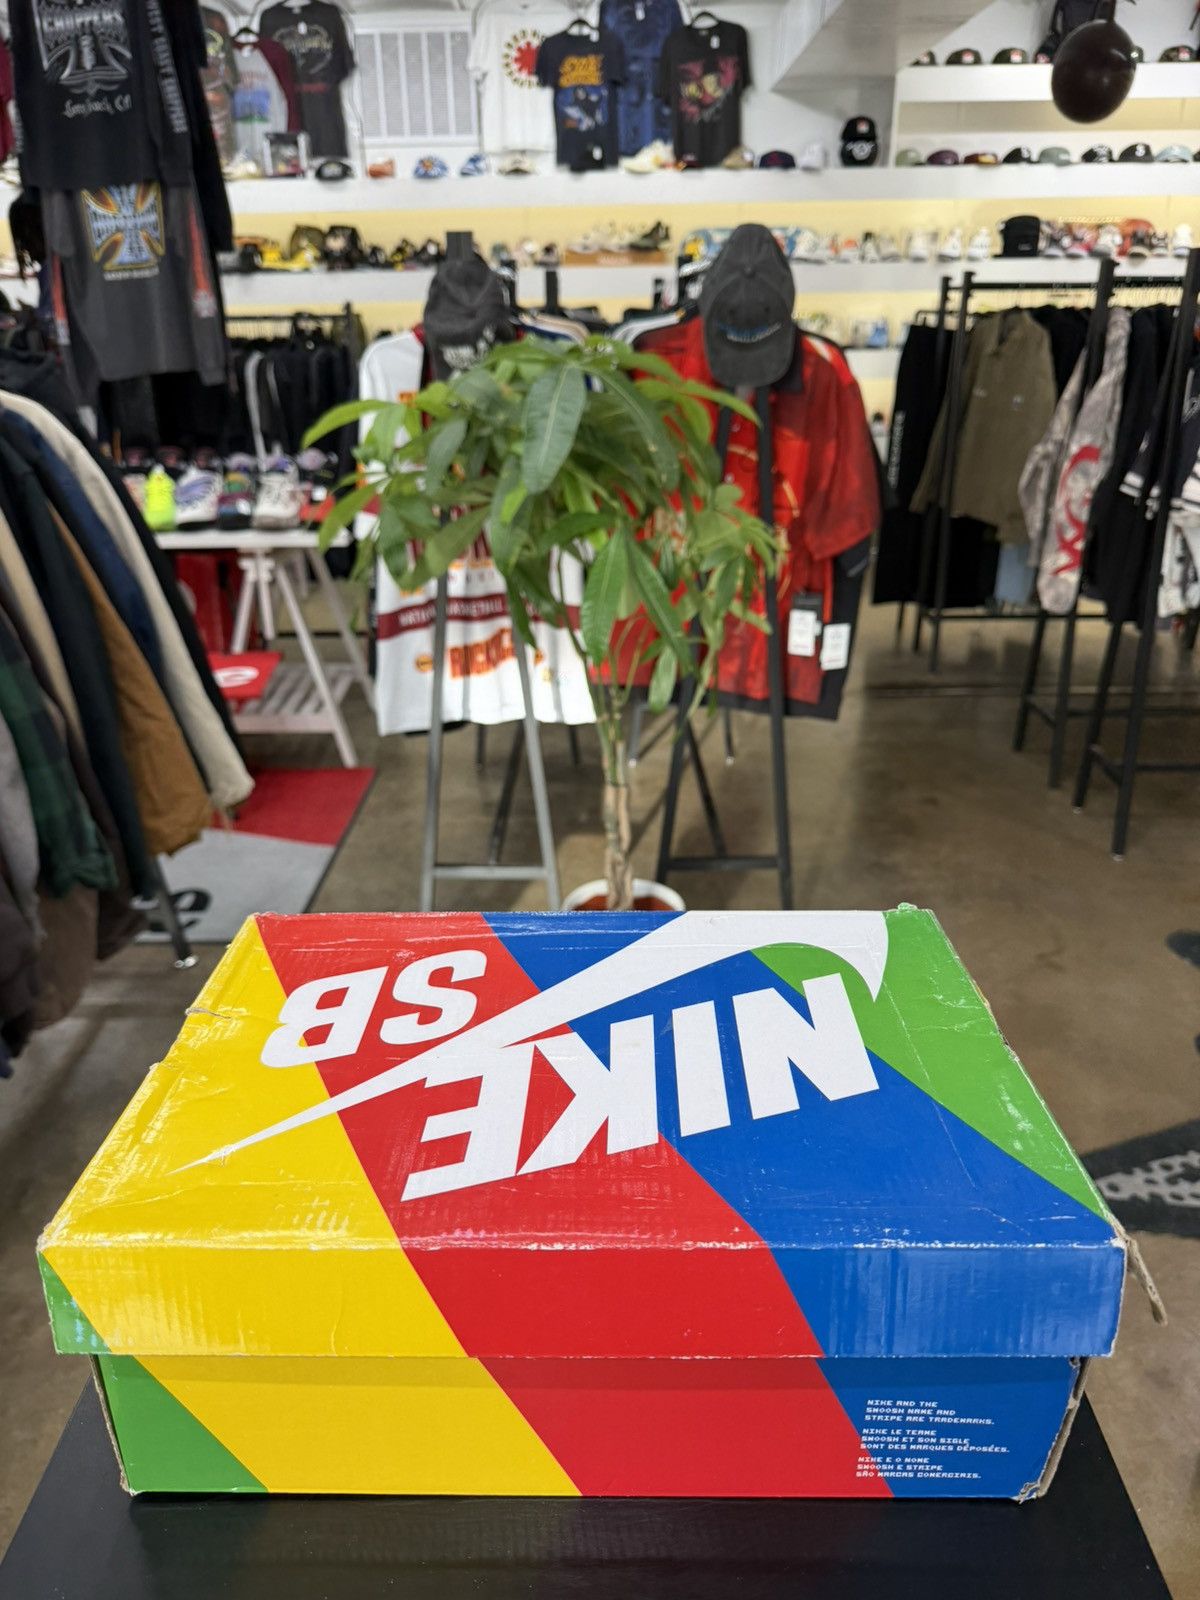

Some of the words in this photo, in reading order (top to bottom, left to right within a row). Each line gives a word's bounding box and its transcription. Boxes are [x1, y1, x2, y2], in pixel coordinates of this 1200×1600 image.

[260, 950, 486, 1068] SB
[401, 972, 880, 1202] NIKE
[928, 1416, 995, 1425] TRADEMARKS.
[861, 1435, 900, 1443] SWOOSH
[956, 1443, 1010, 1453] DÉPOSÉES.
